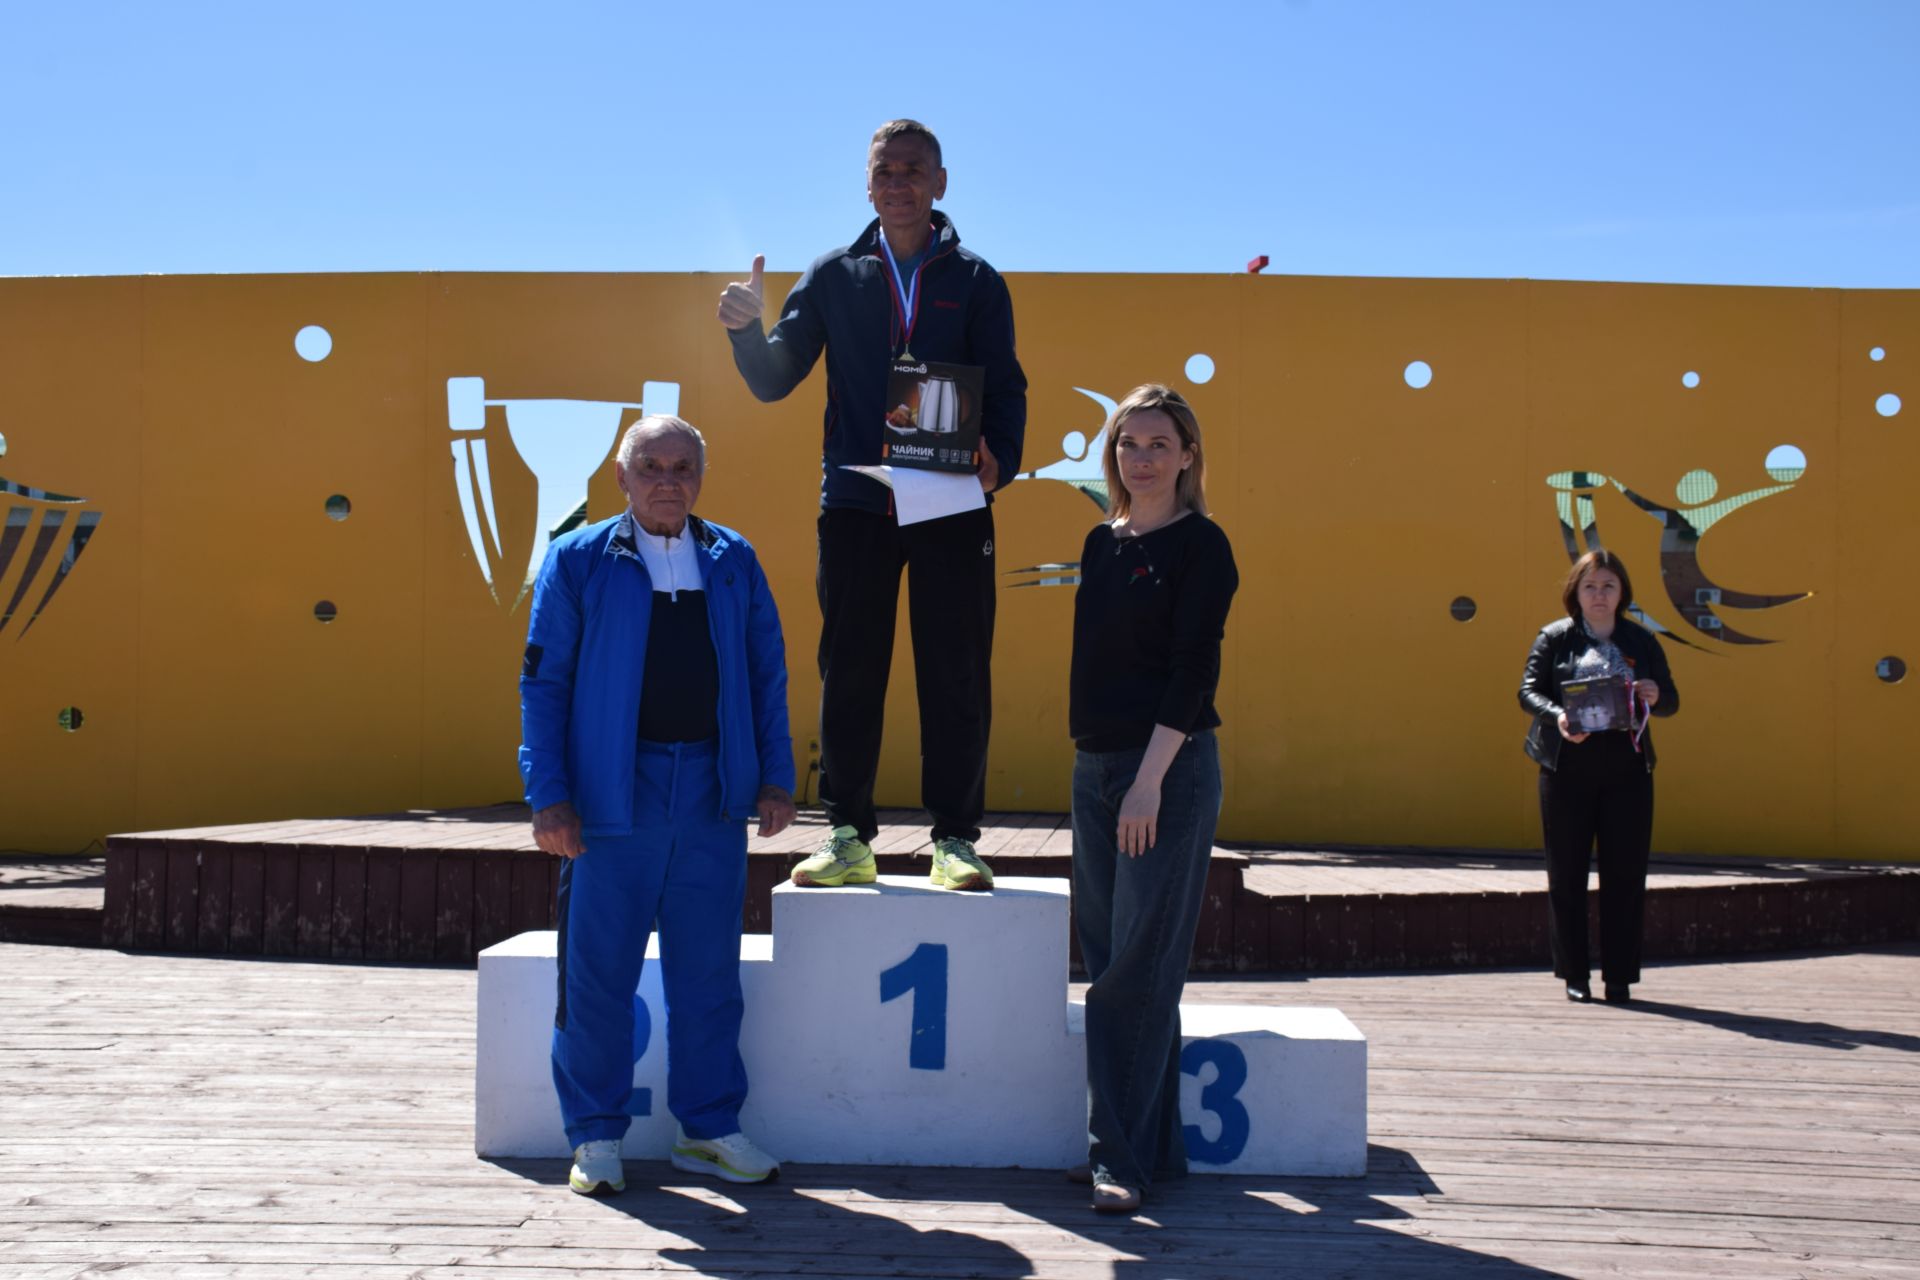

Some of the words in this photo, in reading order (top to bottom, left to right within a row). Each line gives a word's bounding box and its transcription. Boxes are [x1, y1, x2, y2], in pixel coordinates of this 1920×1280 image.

[892, 445, 934, 457] ЧАЙНИК
[879, 942, 948, 1070] 1
[1180, 1039, 1250, 1165] 3
